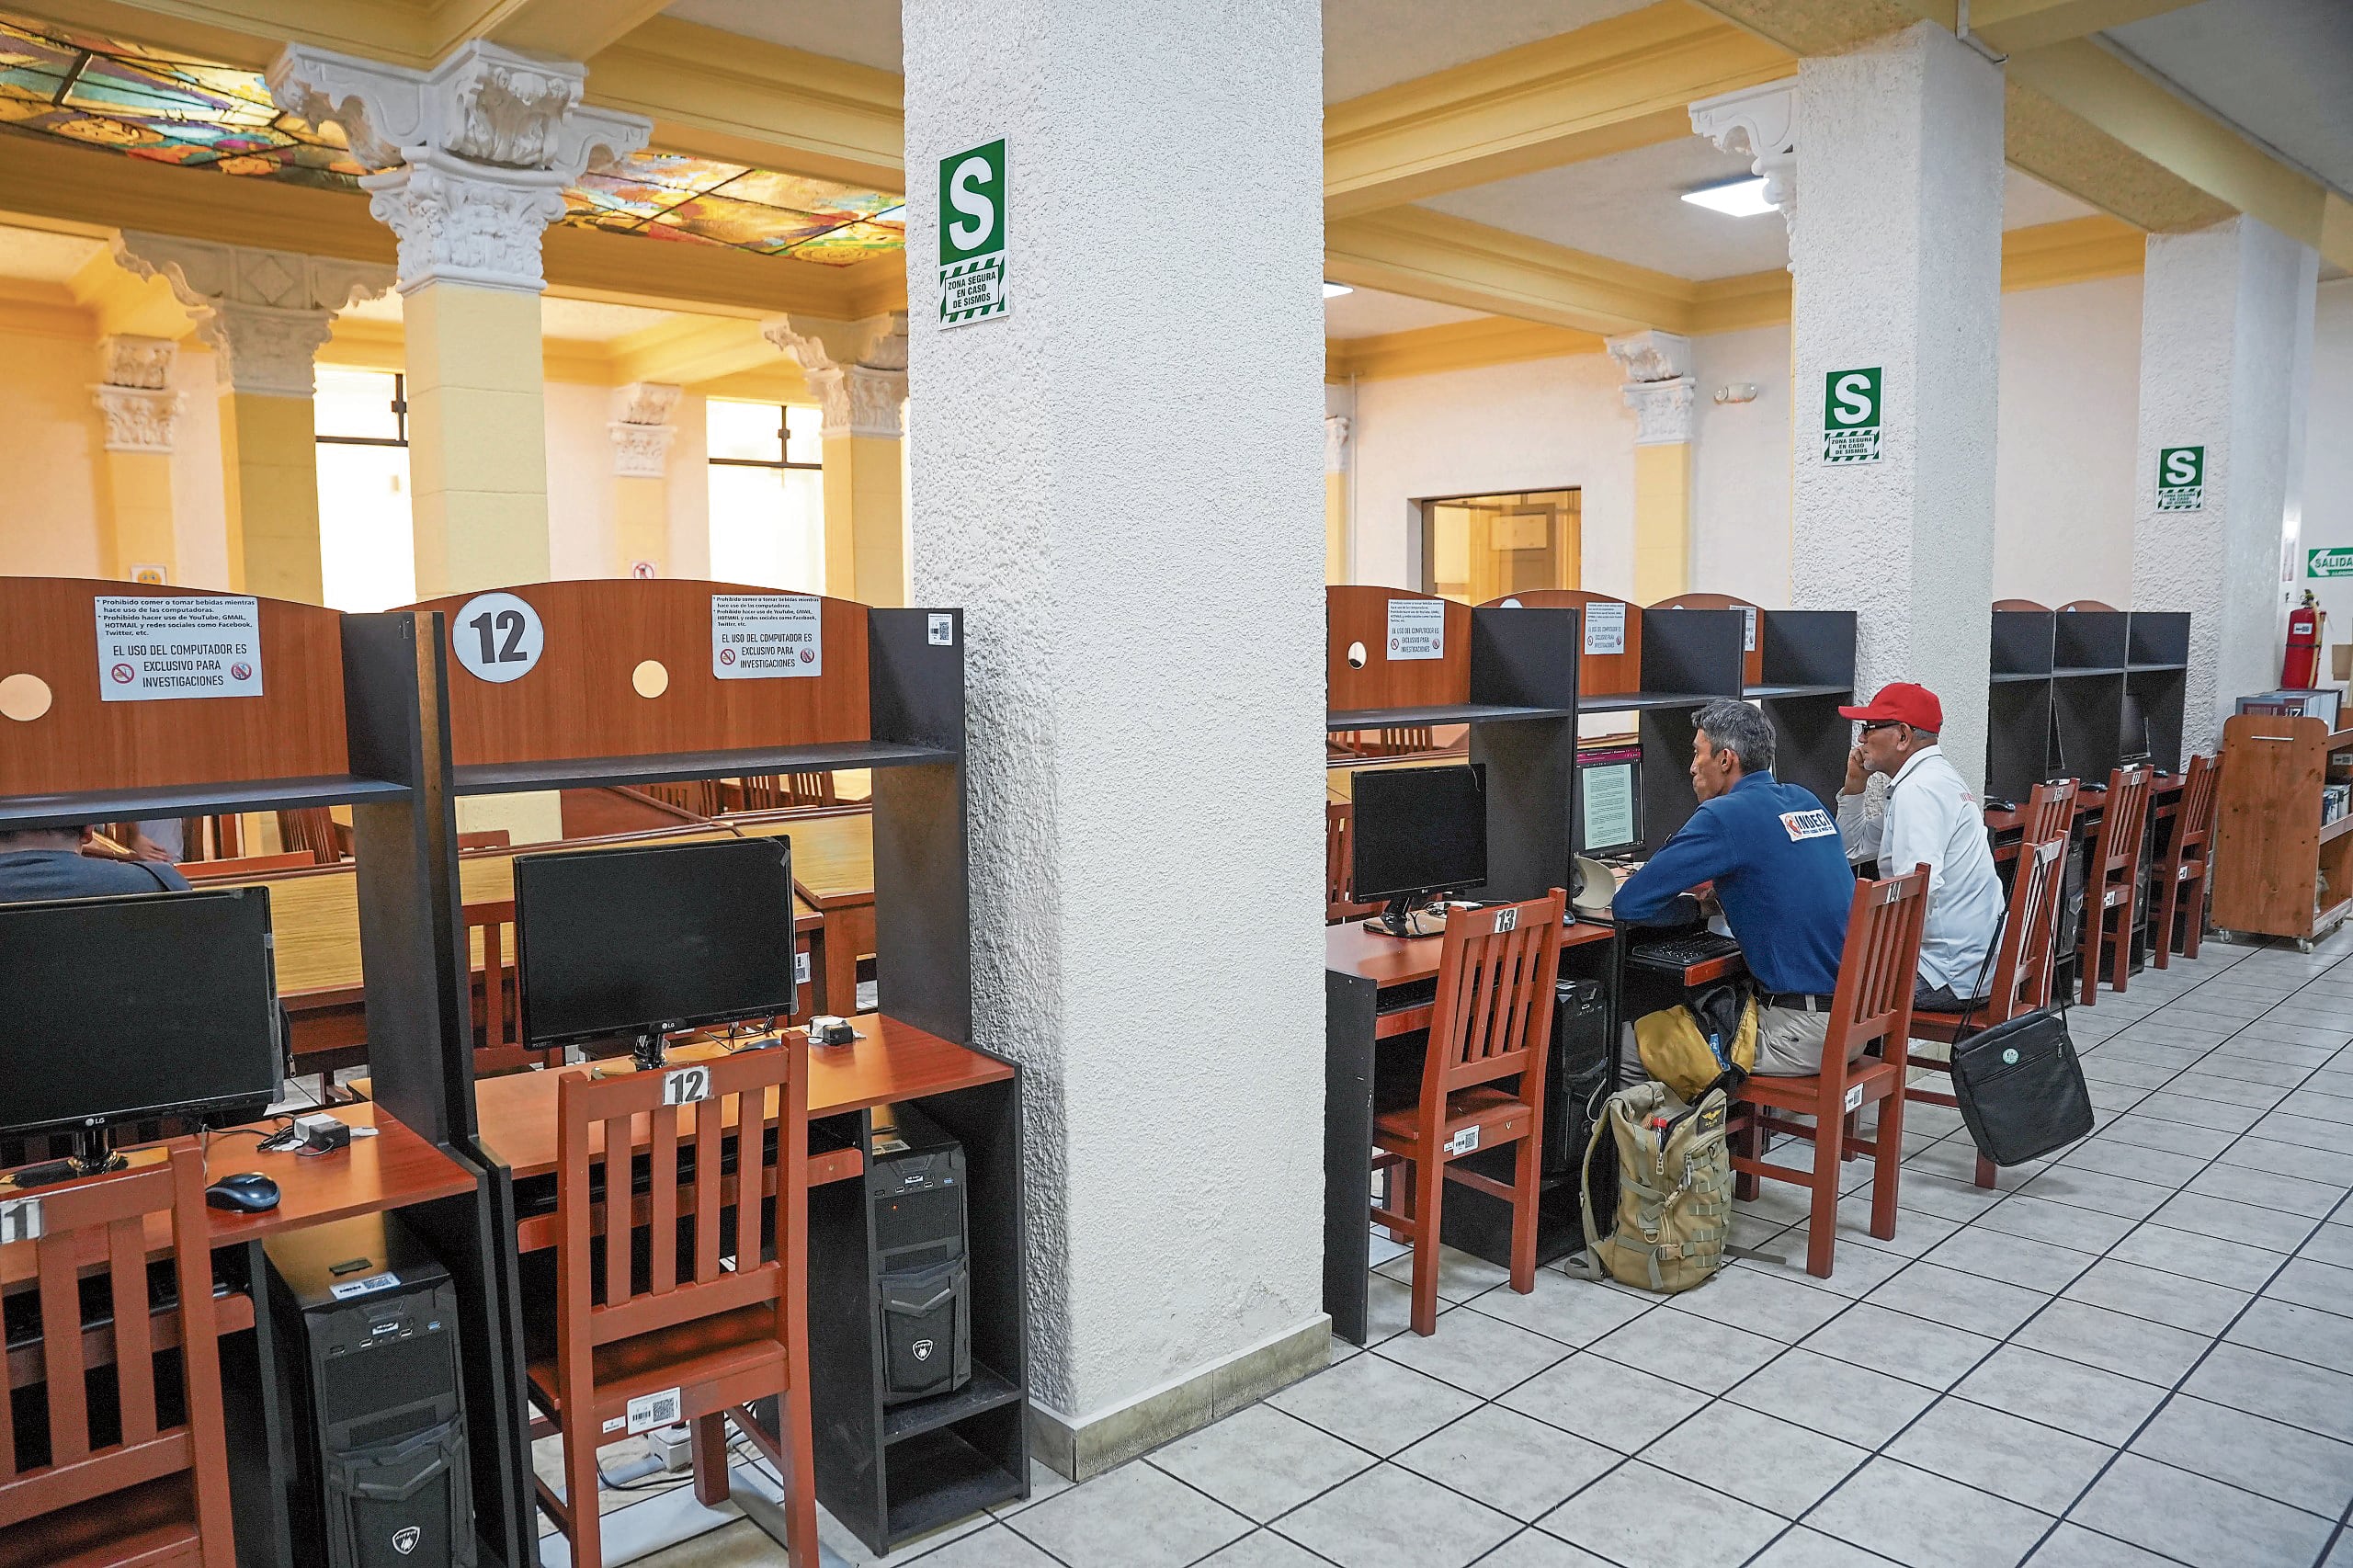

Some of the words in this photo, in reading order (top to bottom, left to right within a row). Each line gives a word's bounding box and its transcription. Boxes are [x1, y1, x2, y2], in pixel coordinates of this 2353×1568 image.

[949, 156, 995, 251] S
[948, 278, 966, 291] ZONA
[968, 271, 996, 286] SEGURA
[957, 288, 966, 298] EN
[967, 284, 986, 296] CASO
[952, 299, 962, 310] DE
[963, 292, 991, 307] SISMOS
[1833, 373, 1872, 425] S
[2165, 449, 2197, 485] S
[2315, 557, 2353, 568] SALIDA
[470, 610, 527, 664] 12
[722, 634, 730, 642] EL
[732, 634, 745, 642] USO
[746, 634, 758, 642] DEL
[760, 634, 802, 642] COMPUTADOR
[113, 645, 125, 656] EL
[128, 645, 147, 656] USO
[150, 645, 167, 655] DEL
[170, 644, 233, 655] COMPUTADOR
[235, 643, 247, 654] ES
[742, 647, 775, 655] EXCLUSIVO
[143, 660, 193, 672] EXCLUSIVO
[196, 660, 222, 670] PARA
[740, 659, 795, 668] INVESTIGACIONES
[142, 676, 224, 688] INVESTIGACIONES
[1794, 812, 1831, 829] INDECI
[1499, 910, 1515, 932] 13
[670, 1071, 704, 1104] 12
[0, 1203, 28, 1242] 1
